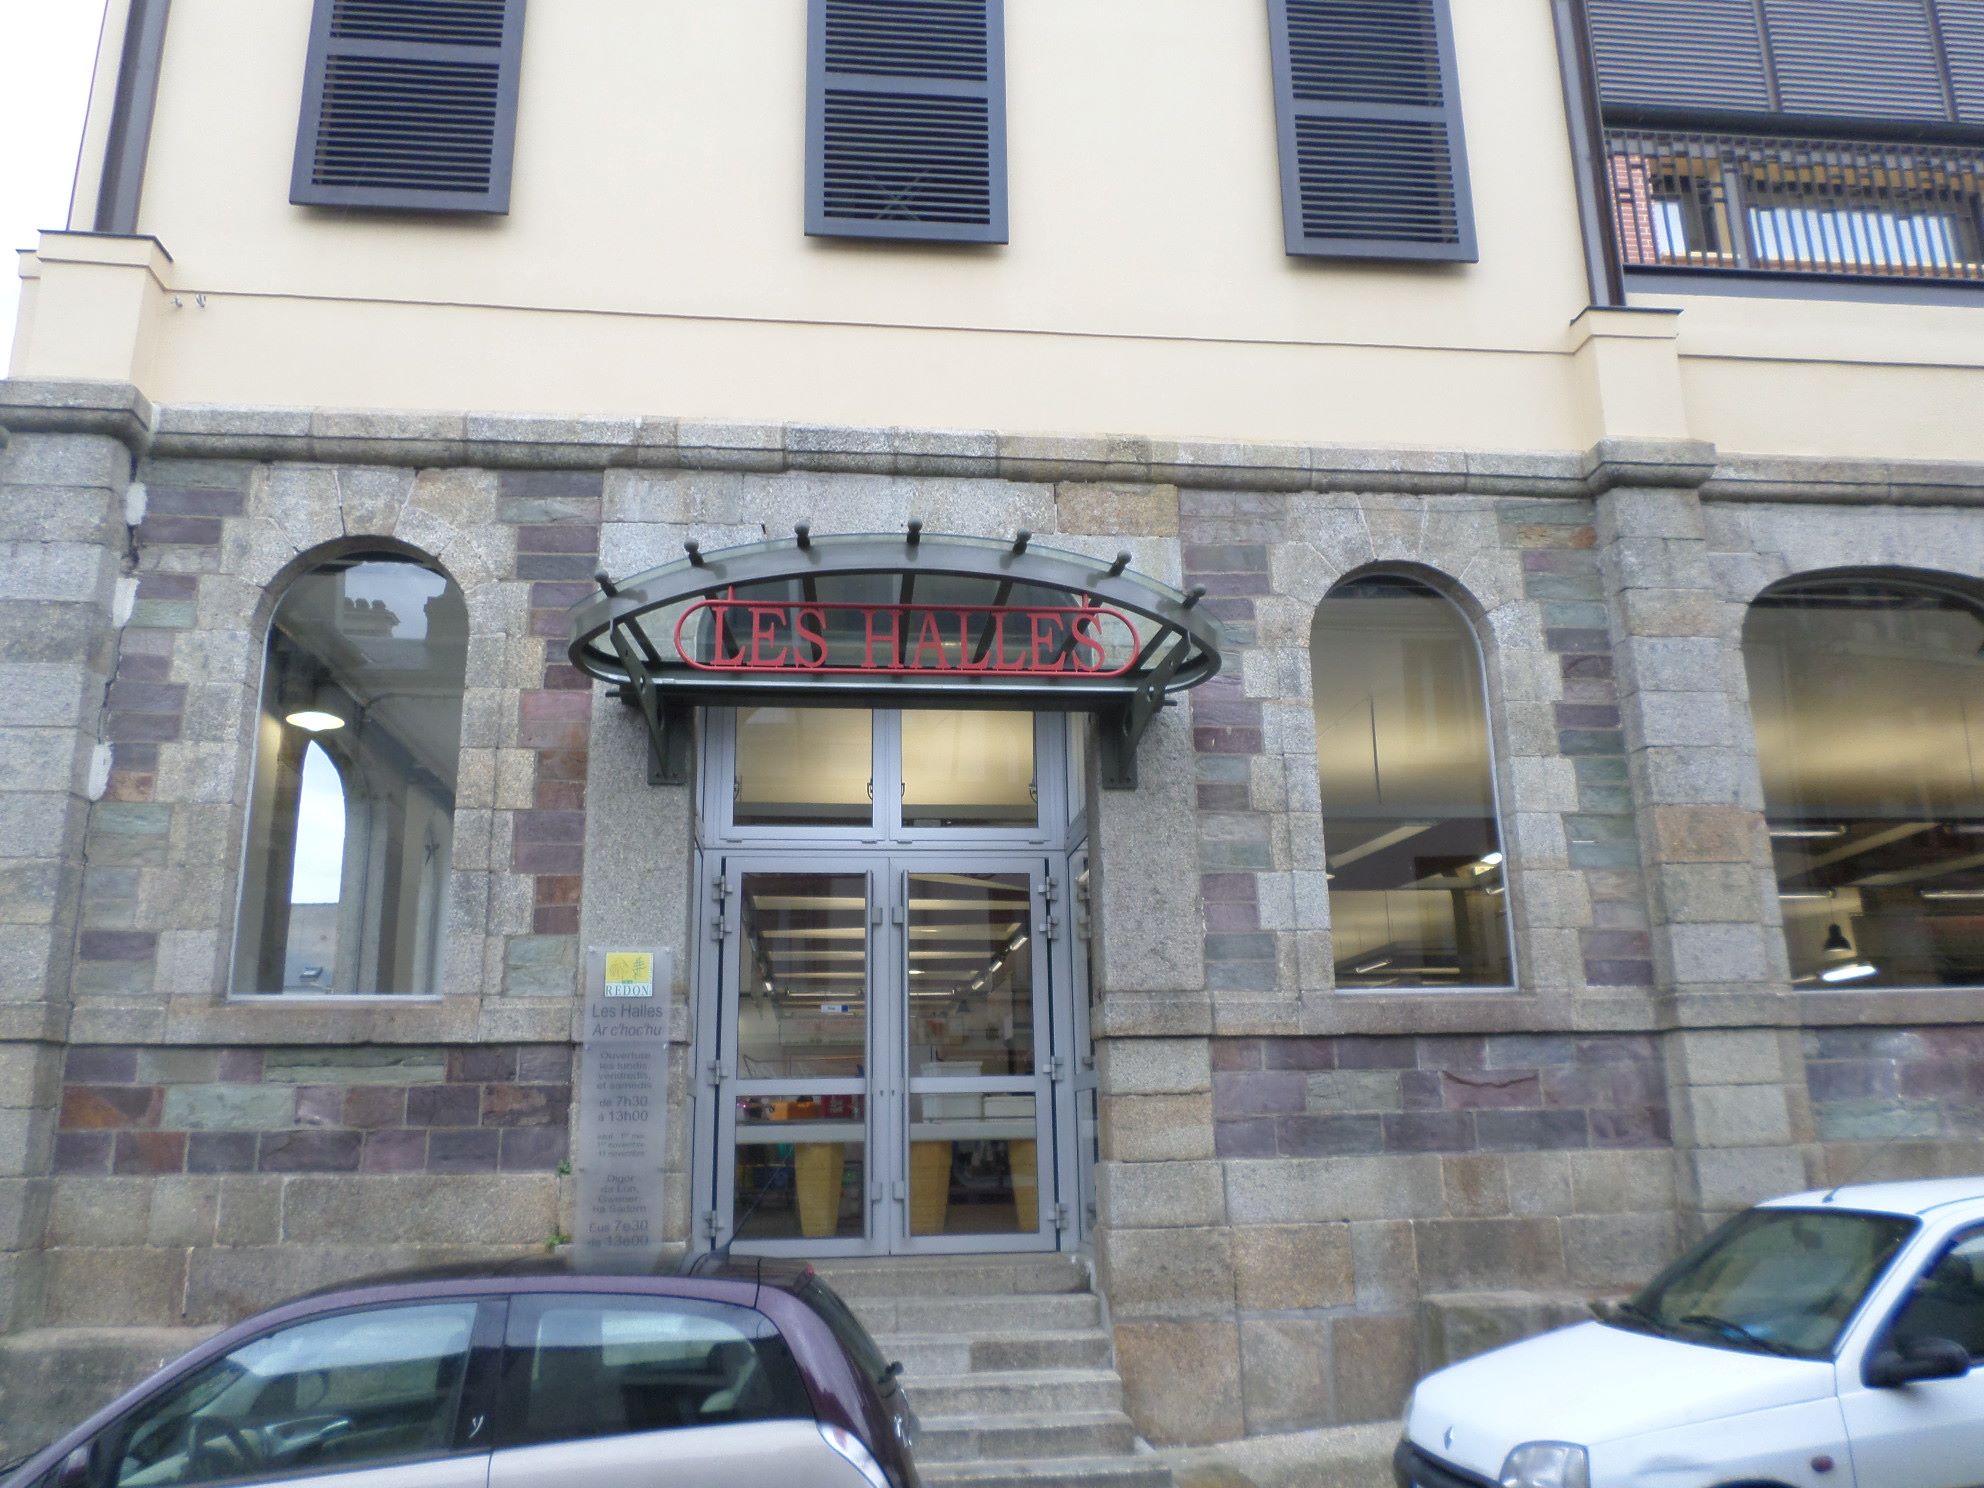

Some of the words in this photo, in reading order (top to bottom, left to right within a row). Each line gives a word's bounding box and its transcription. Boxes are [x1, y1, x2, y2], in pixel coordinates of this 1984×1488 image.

[711, 606, 829, 667] LES
[861, 608, 1106, 672] HALLES
[605, 985, 650, 996] REDON
[592, 1004, 616, 1018] Les
[621, 1004, 663, 1018] Halles
[592, 1024, 608, 1036] Ar
[599, 1097, 612, 1107] de
[617, 1095, 648, 1107] 7h30
[609, 1110, 648, 1121] 13h00
